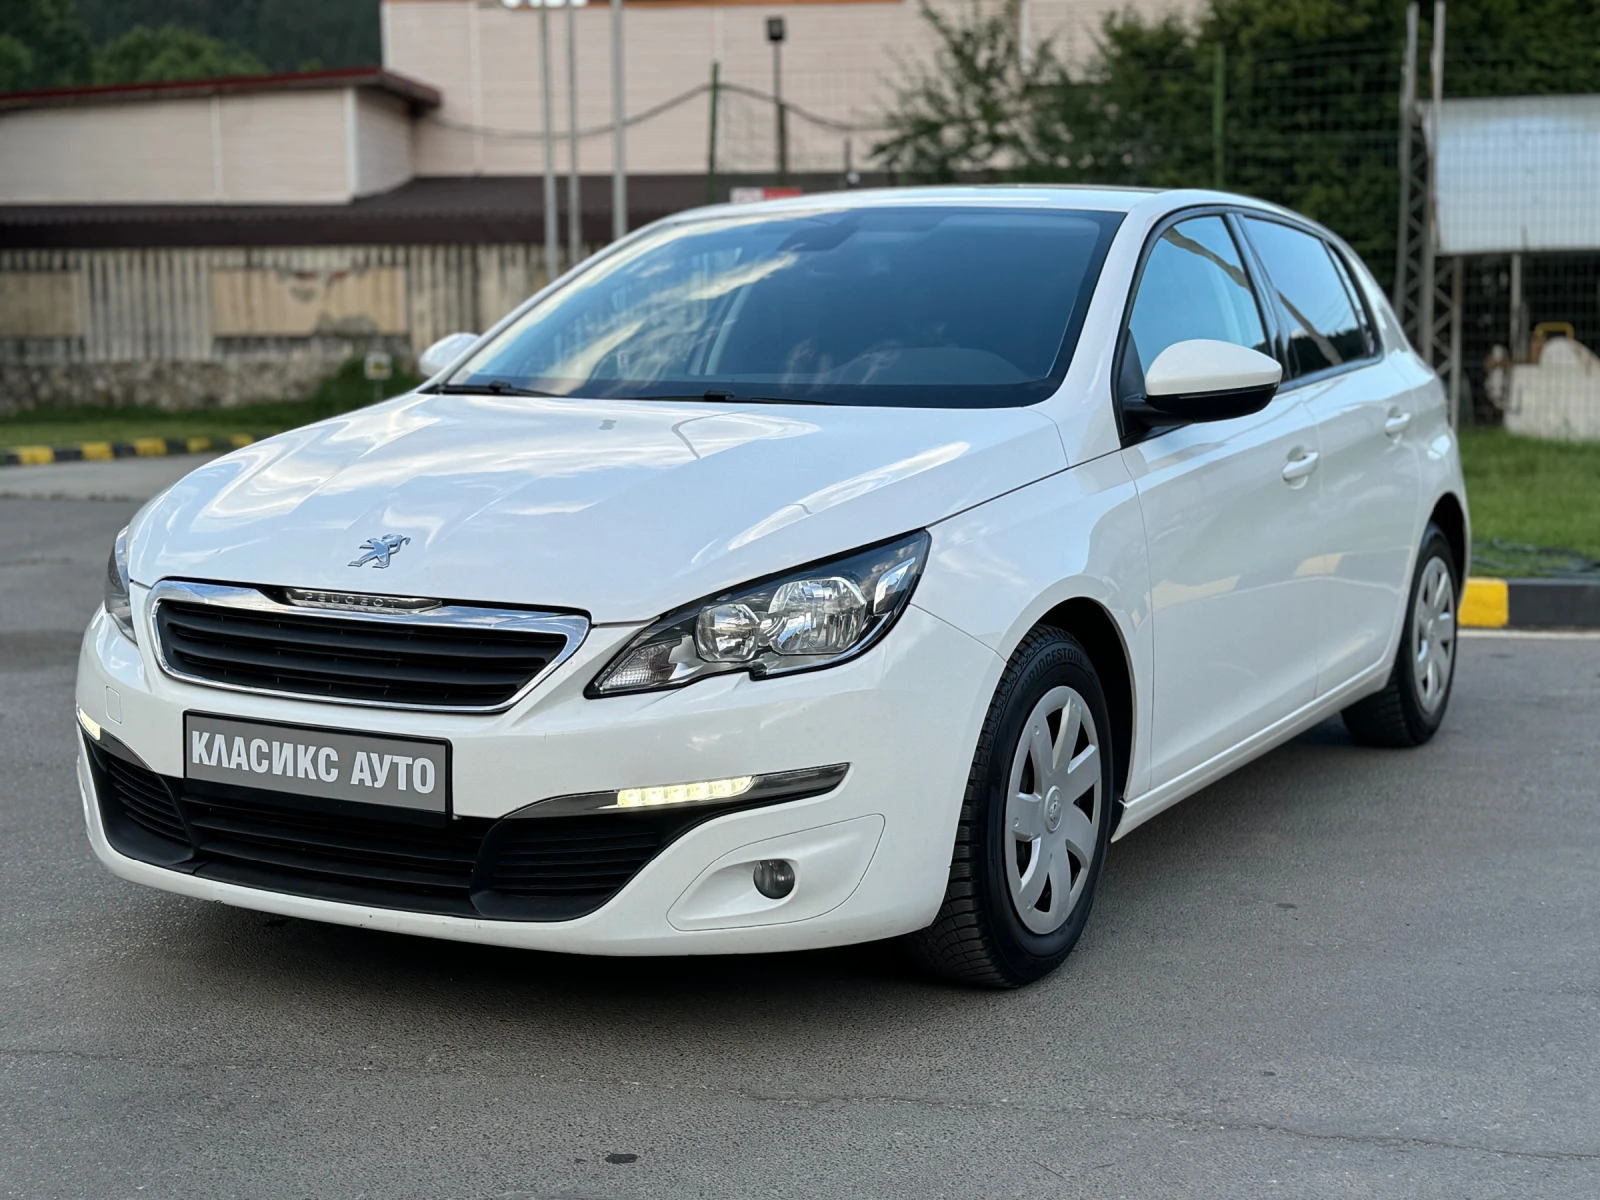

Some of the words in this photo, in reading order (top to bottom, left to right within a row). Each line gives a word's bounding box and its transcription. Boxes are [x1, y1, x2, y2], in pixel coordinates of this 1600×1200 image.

[304, 592, 400, 608] PEUGEOT
[192, 730, 339, 783] КЛАСИКС
[350, 751, 435, 794] АУТО
